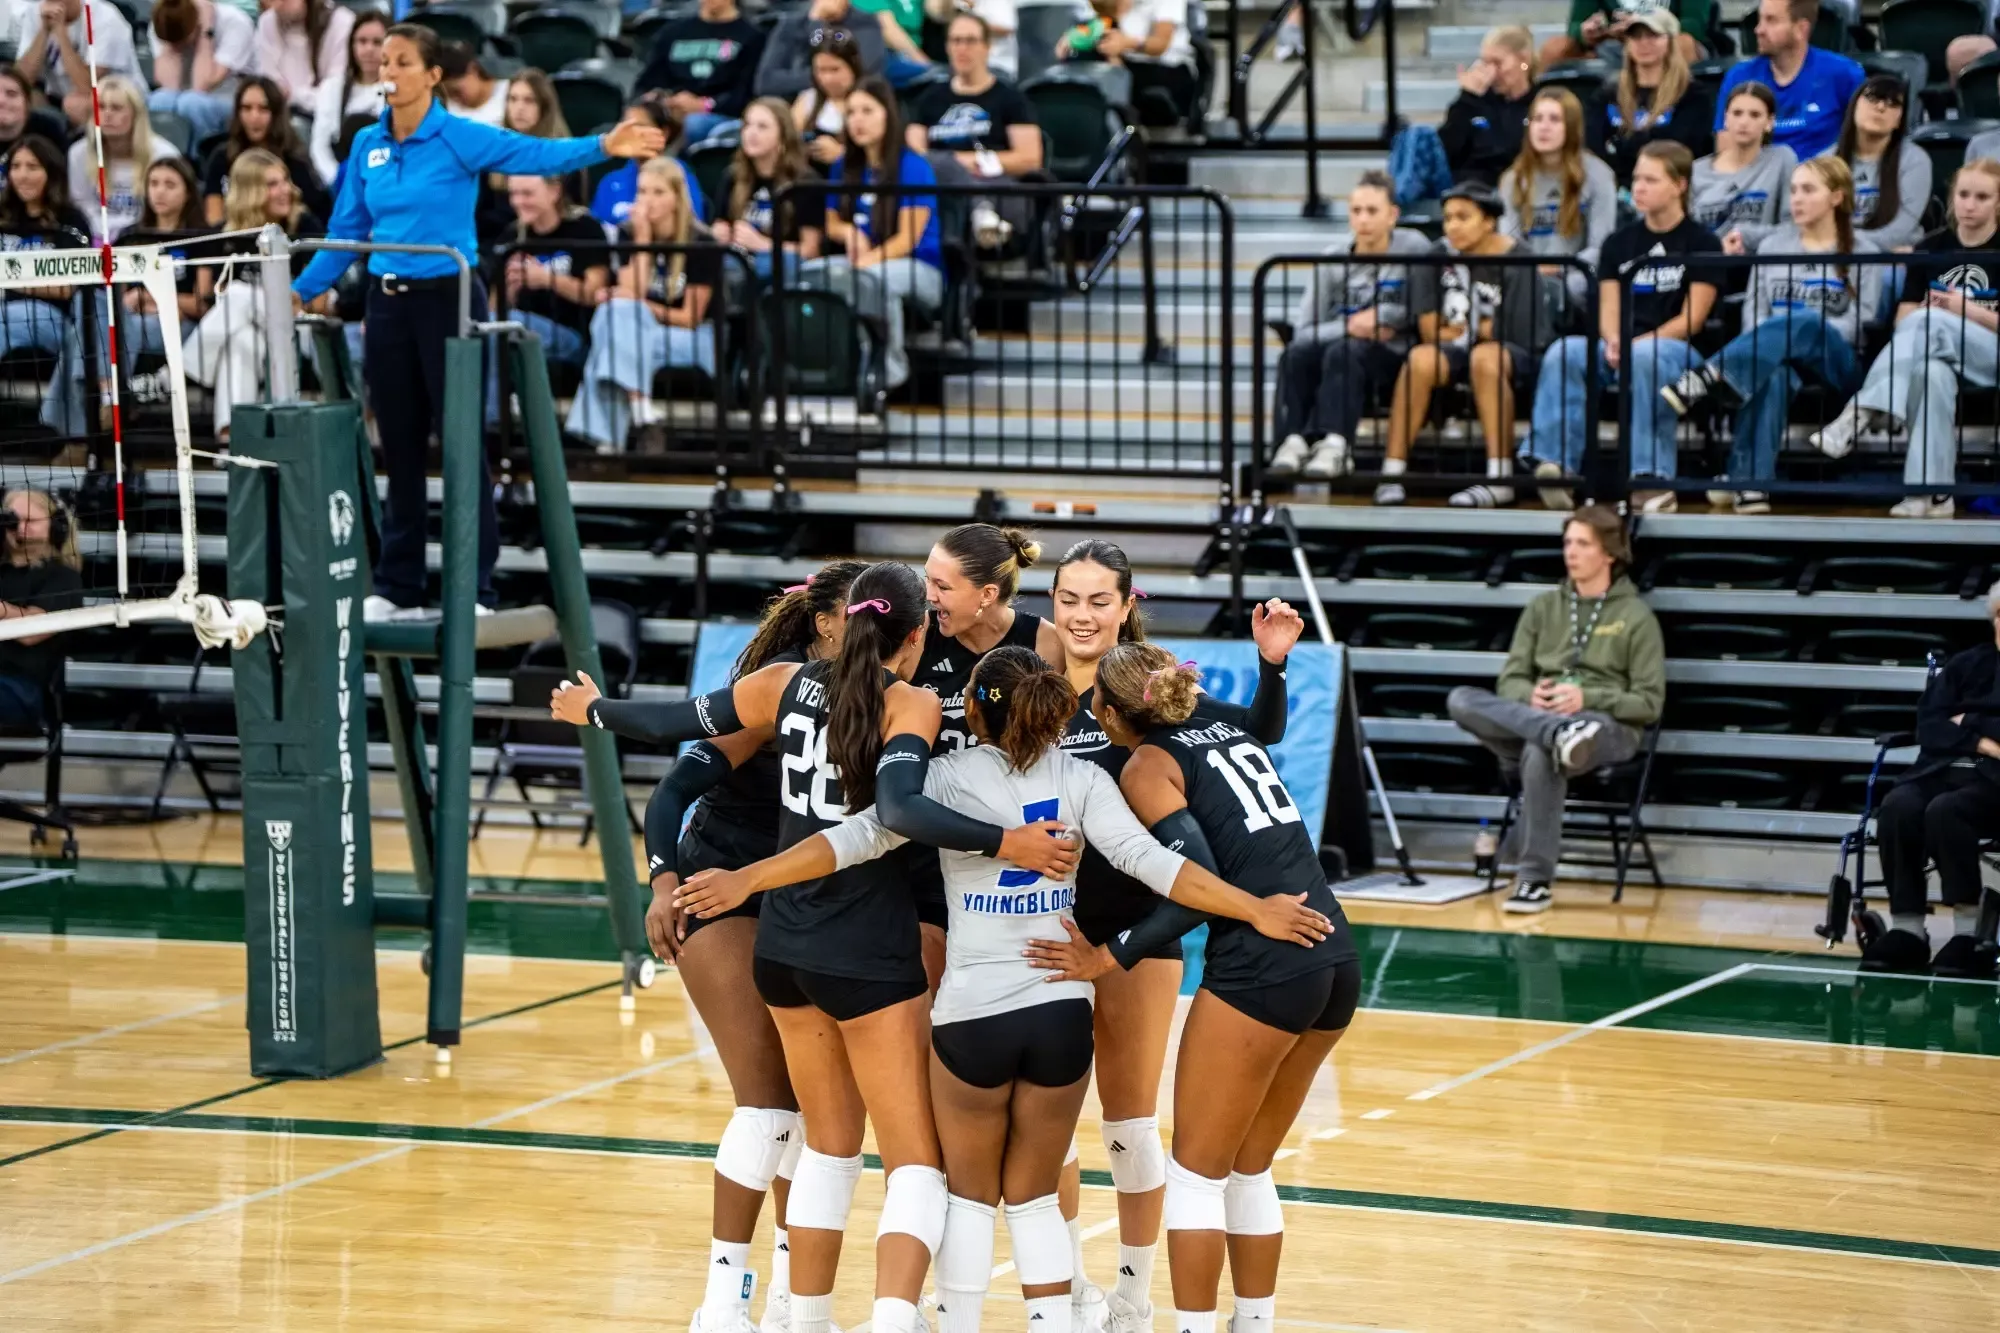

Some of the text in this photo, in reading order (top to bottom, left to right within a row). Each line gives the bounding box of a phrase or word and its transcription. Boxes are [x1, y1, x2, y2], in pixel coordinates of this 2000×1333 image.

[34, 256, 118, 276] WOLVERINS
[336, 597, 356, 906] WOLVERINES
[1170, 721, 1246, 748] MARTNEZ
[1206, 742, 1302, 834] 18
